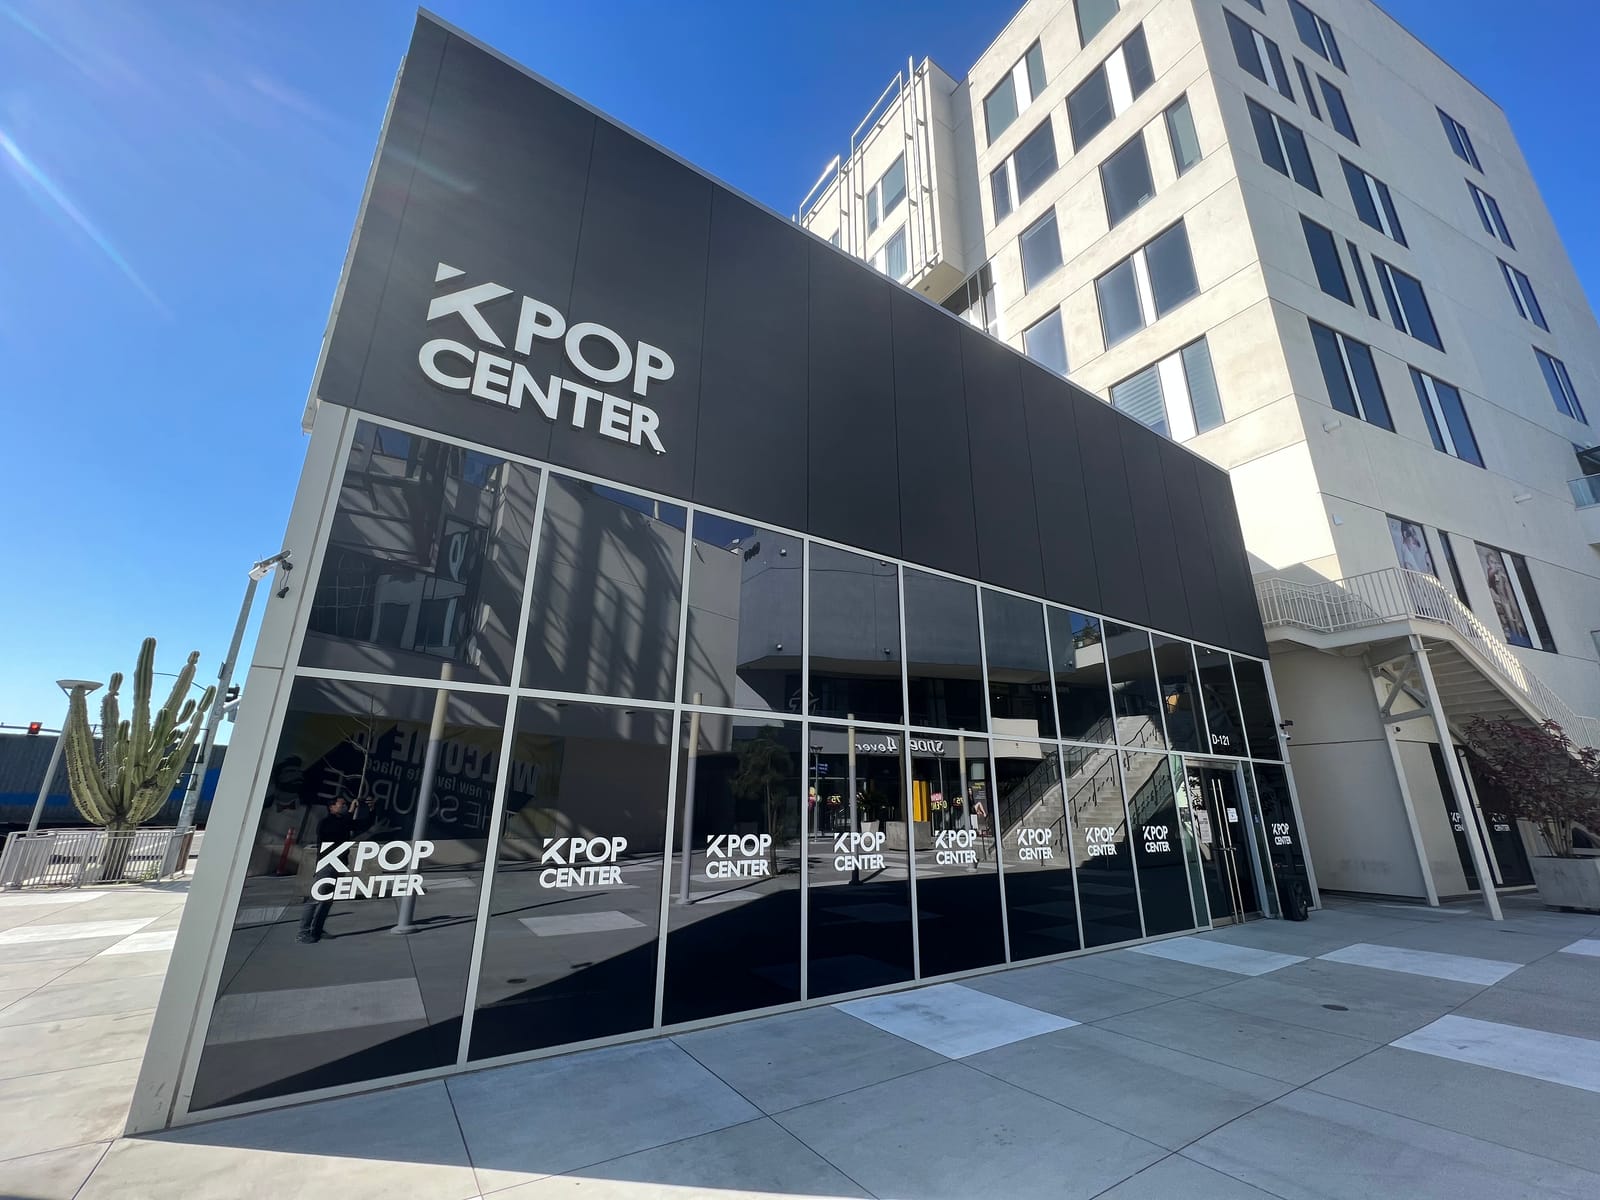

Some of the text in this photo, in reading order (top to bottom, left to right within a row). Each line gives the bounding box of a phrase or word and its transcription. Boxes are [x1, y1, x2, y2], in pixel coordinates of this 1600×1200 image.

[427, 262, 675, 397] KPOP
[418, 338, 667, 453] CENTER
[1212, 734, 1230, 746] D-121
[1018, 847, 1054, 861] CENTER
[1087, 844, 1118, 857] CENTER
[1145, 841, 1171, 854] CENTER
[833, 854, 886, 872] CENTER
[936, 850, 979, 866] CENTER
[539, 865, 624, 889] CENTER
[705, 859, 771, 879] CENTER
[311, 874, 426, 901] CENTER
